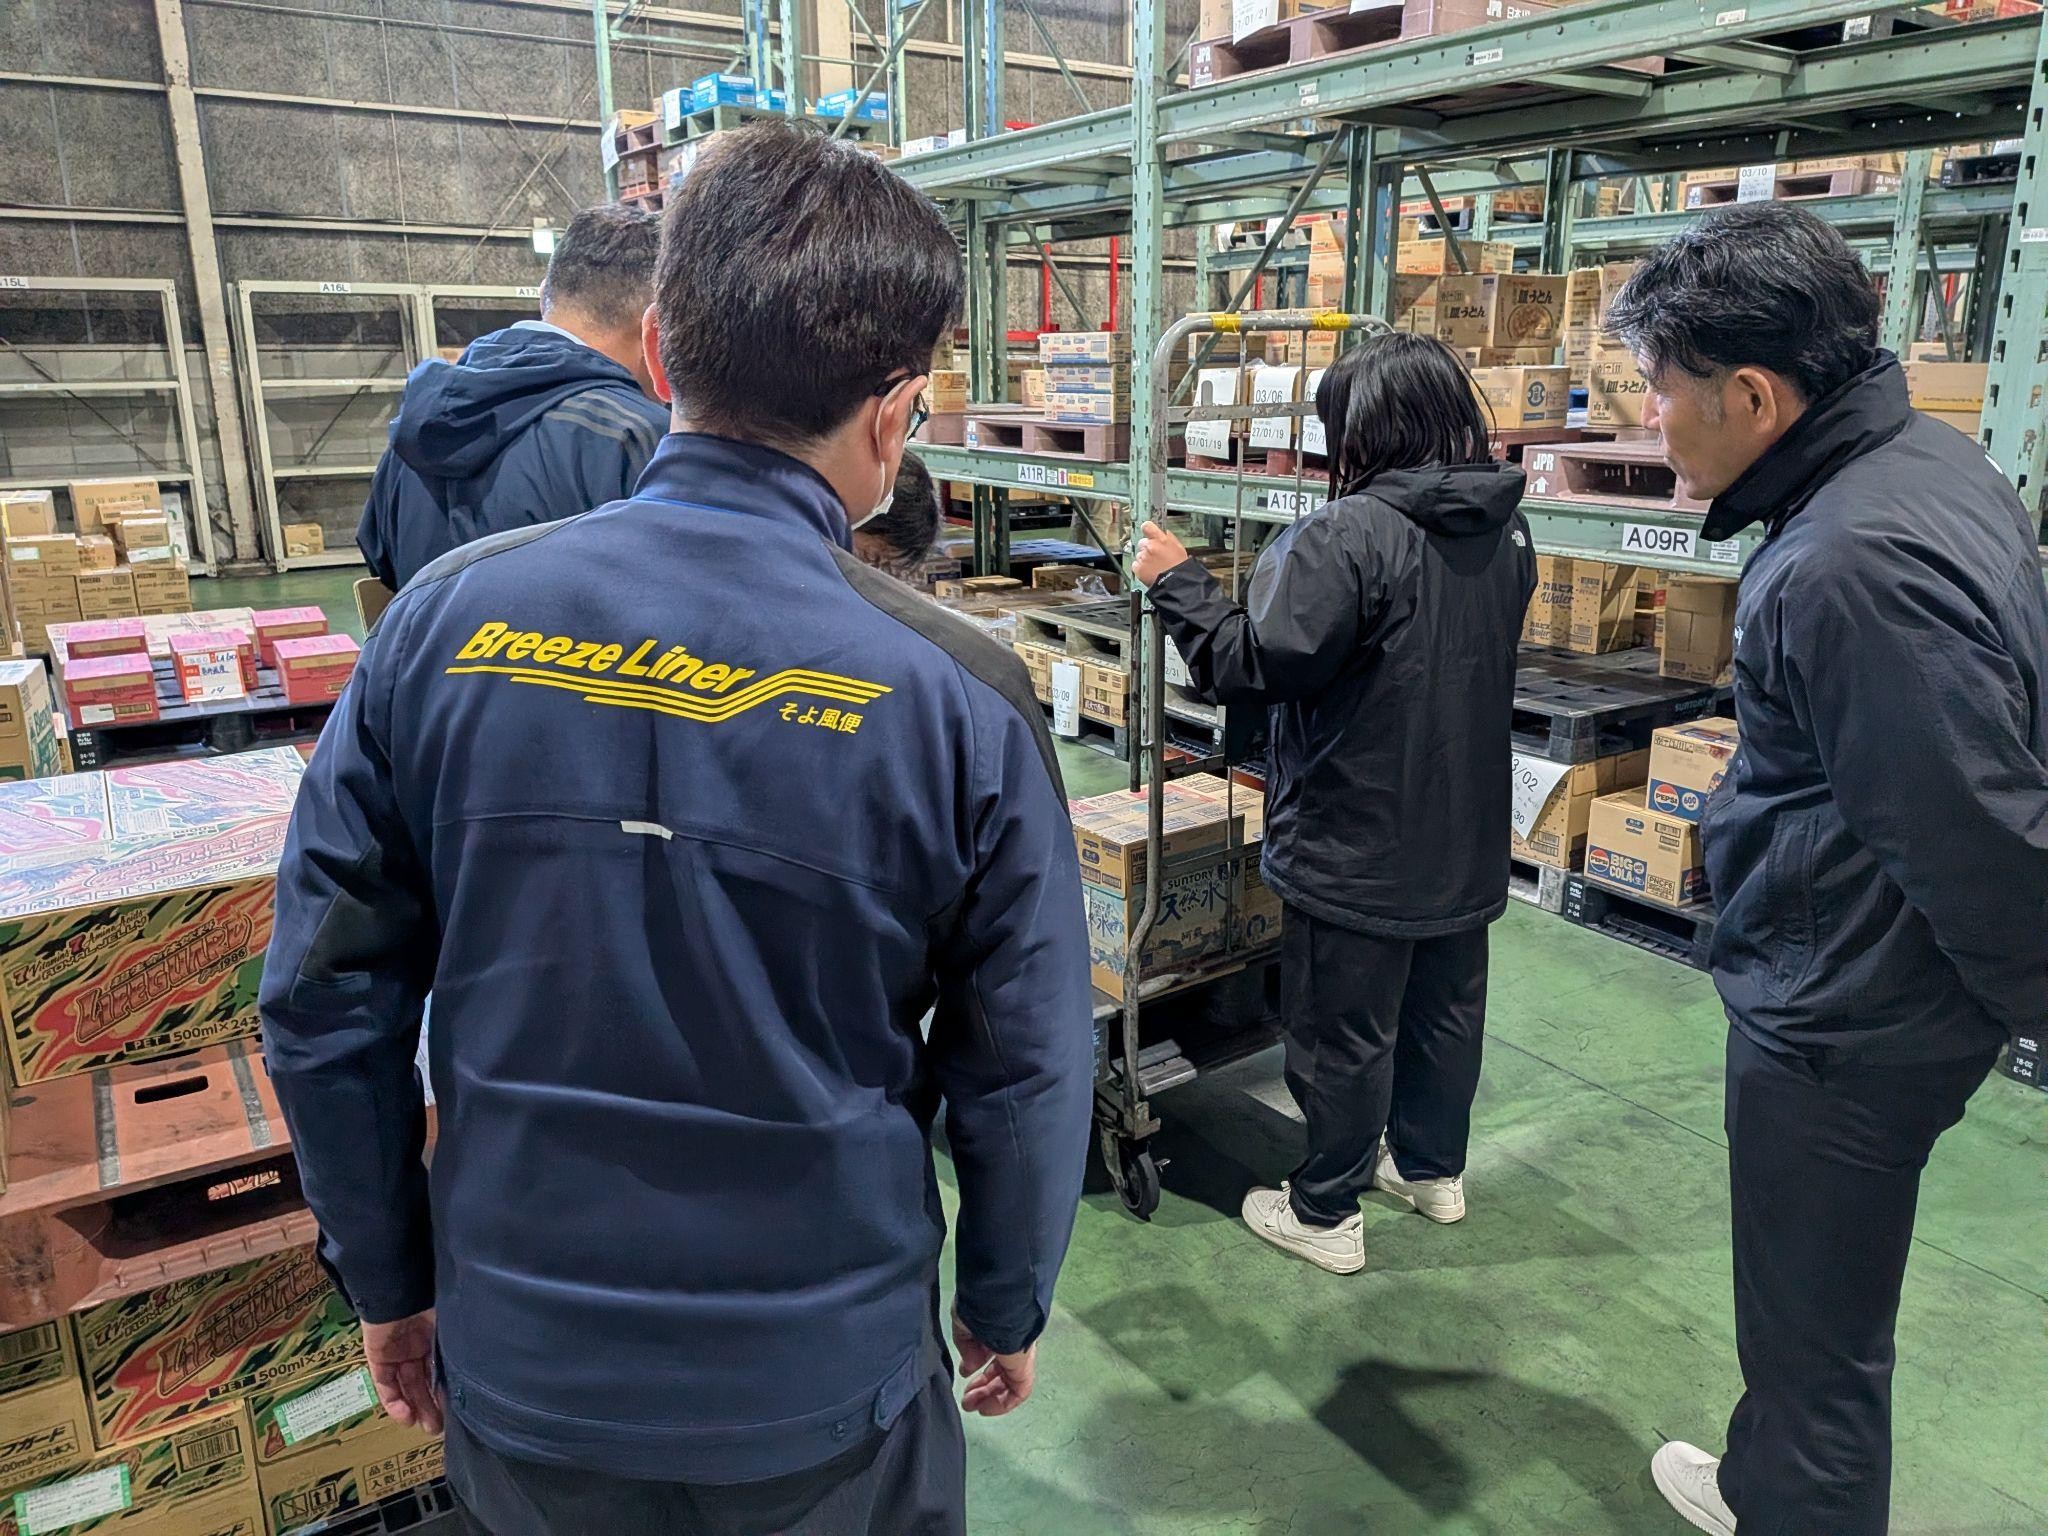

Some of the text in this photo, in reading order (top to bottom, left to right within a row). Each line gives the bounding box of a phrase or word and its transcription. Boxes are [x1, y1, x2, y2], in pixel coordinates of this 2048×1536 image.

[1741, 167, 1768, 178] 03/10
[322, 283, 349, 293] A16L
[1255, 390, 1283, 403] 03/06
[1187, 435, 1222, 449] 27/01/19
[1251, 427, 1285, 439] 27/01/19
[1533, 453, 1555, 472] JPR
[1019, 465, 1044, 481] A11R
[1626, 526, 1689, 553] A09R
[455, 621, 755, 693] Breeze Liner
[778, 702, 864, 734] そよ風便
[1655, 793, 1678, 805] PEPSI
[1610, 853, 1634, 872] BIG
[1167, 868, 1214, 889] SUNTORY
[1609, 865, 1633, 883] COLA
[1156, 882, 1228, 926] 天然水
[28, 950, 70, 977] Vitamins
[69, 934, 86, 954] 7
[42, 917, 147, 980] ROYAL JELLY
[219, 949, 248, 970] 1986
[76, 913, 253, 1043] LIFEGUARD
[134, 1035, 161, 1049] PET
[2013, 1065, 2032, 1077] E-04
[2016, 1057, 2034, 1069] 18-02
[159, 1256, 320, 1397] LIFEGUAR
[219, 1378, 247, 1394] PET
[369, 1459, 395, 1477] 品名
[402, 1462, 424, 1478] PET
[371, 1473, 396, 1491] 入数
